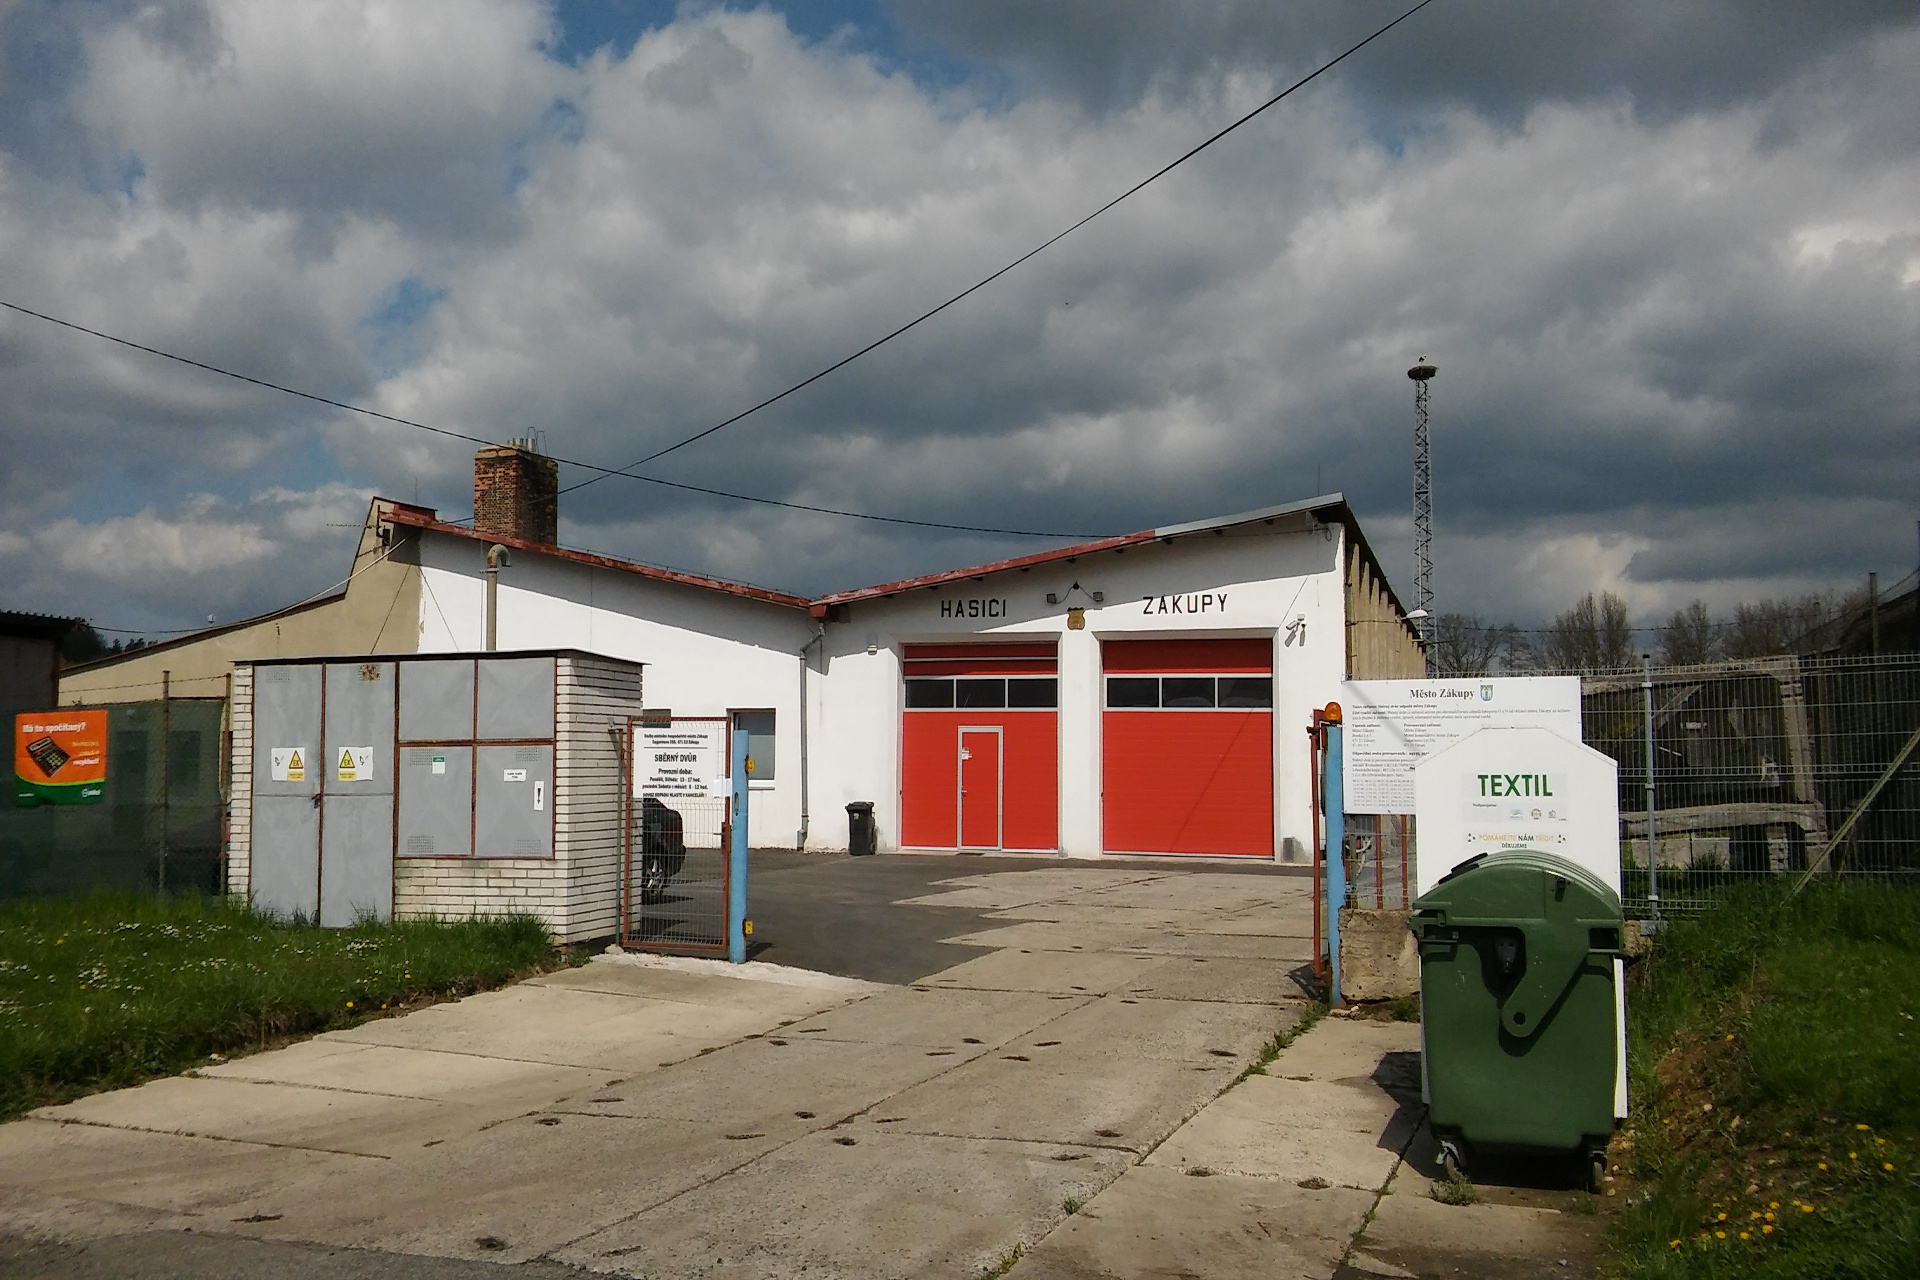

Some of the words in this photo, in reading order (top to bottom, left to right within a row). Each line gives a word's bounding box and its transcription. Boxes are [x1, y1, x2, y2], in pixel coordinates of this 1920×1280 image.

[1142, 593, 1228, 615] ZÁKUPY
[1410, 688, 1437, 699] Město
[1439, 688, 1475, 700] Zákupy
[654, 752, 679, 763] SBĚRNÝ
[680, 752, 697, 763] DVŮR
[1477, 774, 1553, 796] TEXTIL
[1517, 834, 1534, 842] NÁM
